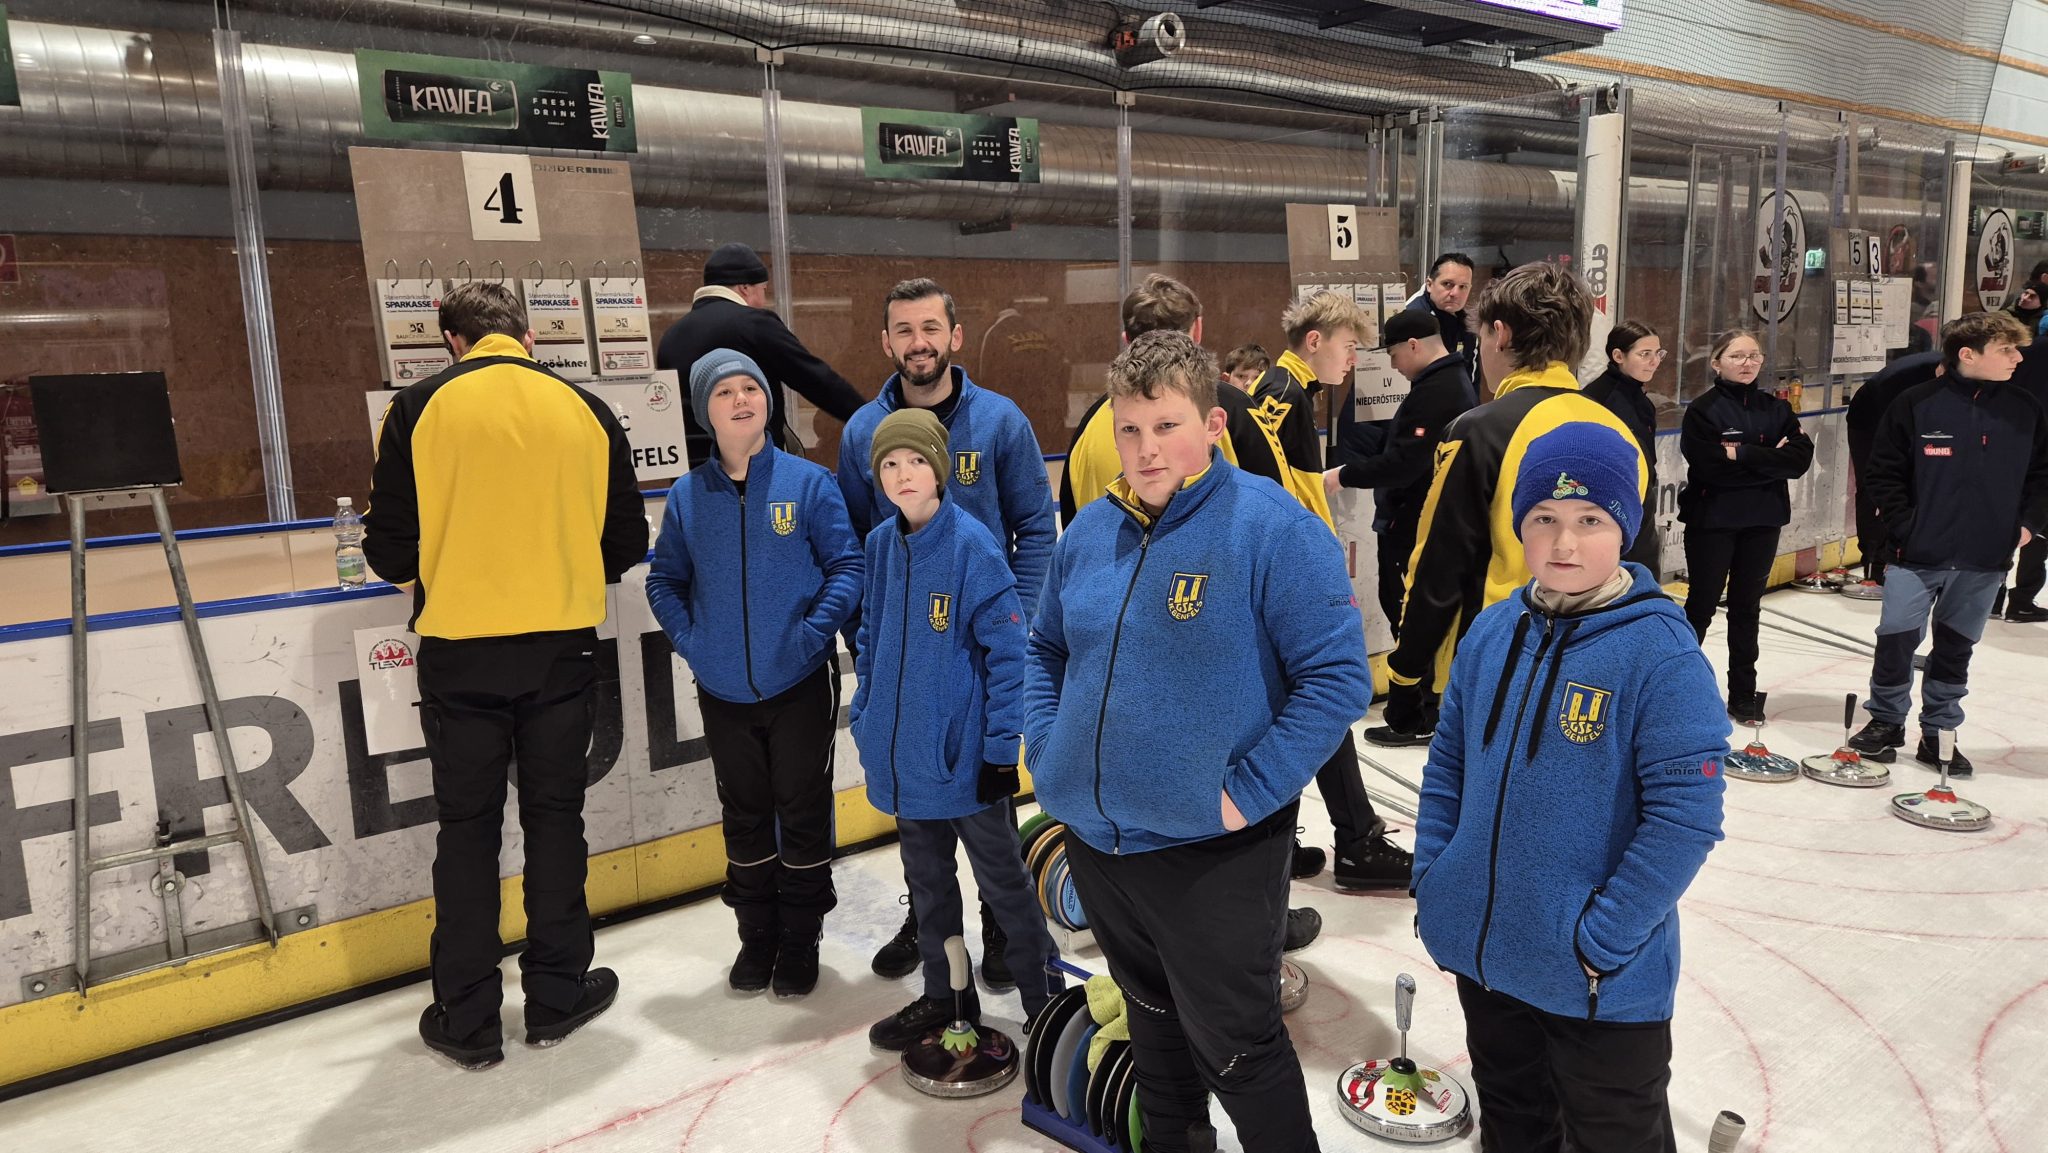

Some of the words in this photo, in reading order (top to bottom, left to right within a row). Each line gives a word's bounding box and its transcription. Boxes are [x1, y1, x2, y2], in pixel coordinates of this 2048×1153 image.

[409, 84, 493, 116] KAWEA
[532, 97, 575, 107] FRESH
[587, 82, 610, 139] KAWEA
[533, 108, 576, 118] DRINK
[894, 133, 947, 157] KAWEA
[1008, 127, 1023, 173] KAWEA
[483, 172, 523, 224] 4
[1336, 215, 1352, 249] 5
[1853, 241, 1861, 265] 5
[1871, 242, 1880, 274] 3
[385, 300, 432, 308] SPARKASSE
[529, 299, 571, 307] SPARKASSE
[595, 297, 635, 305] SPARKASSE
[1383, 377, 1392, 388] LV
